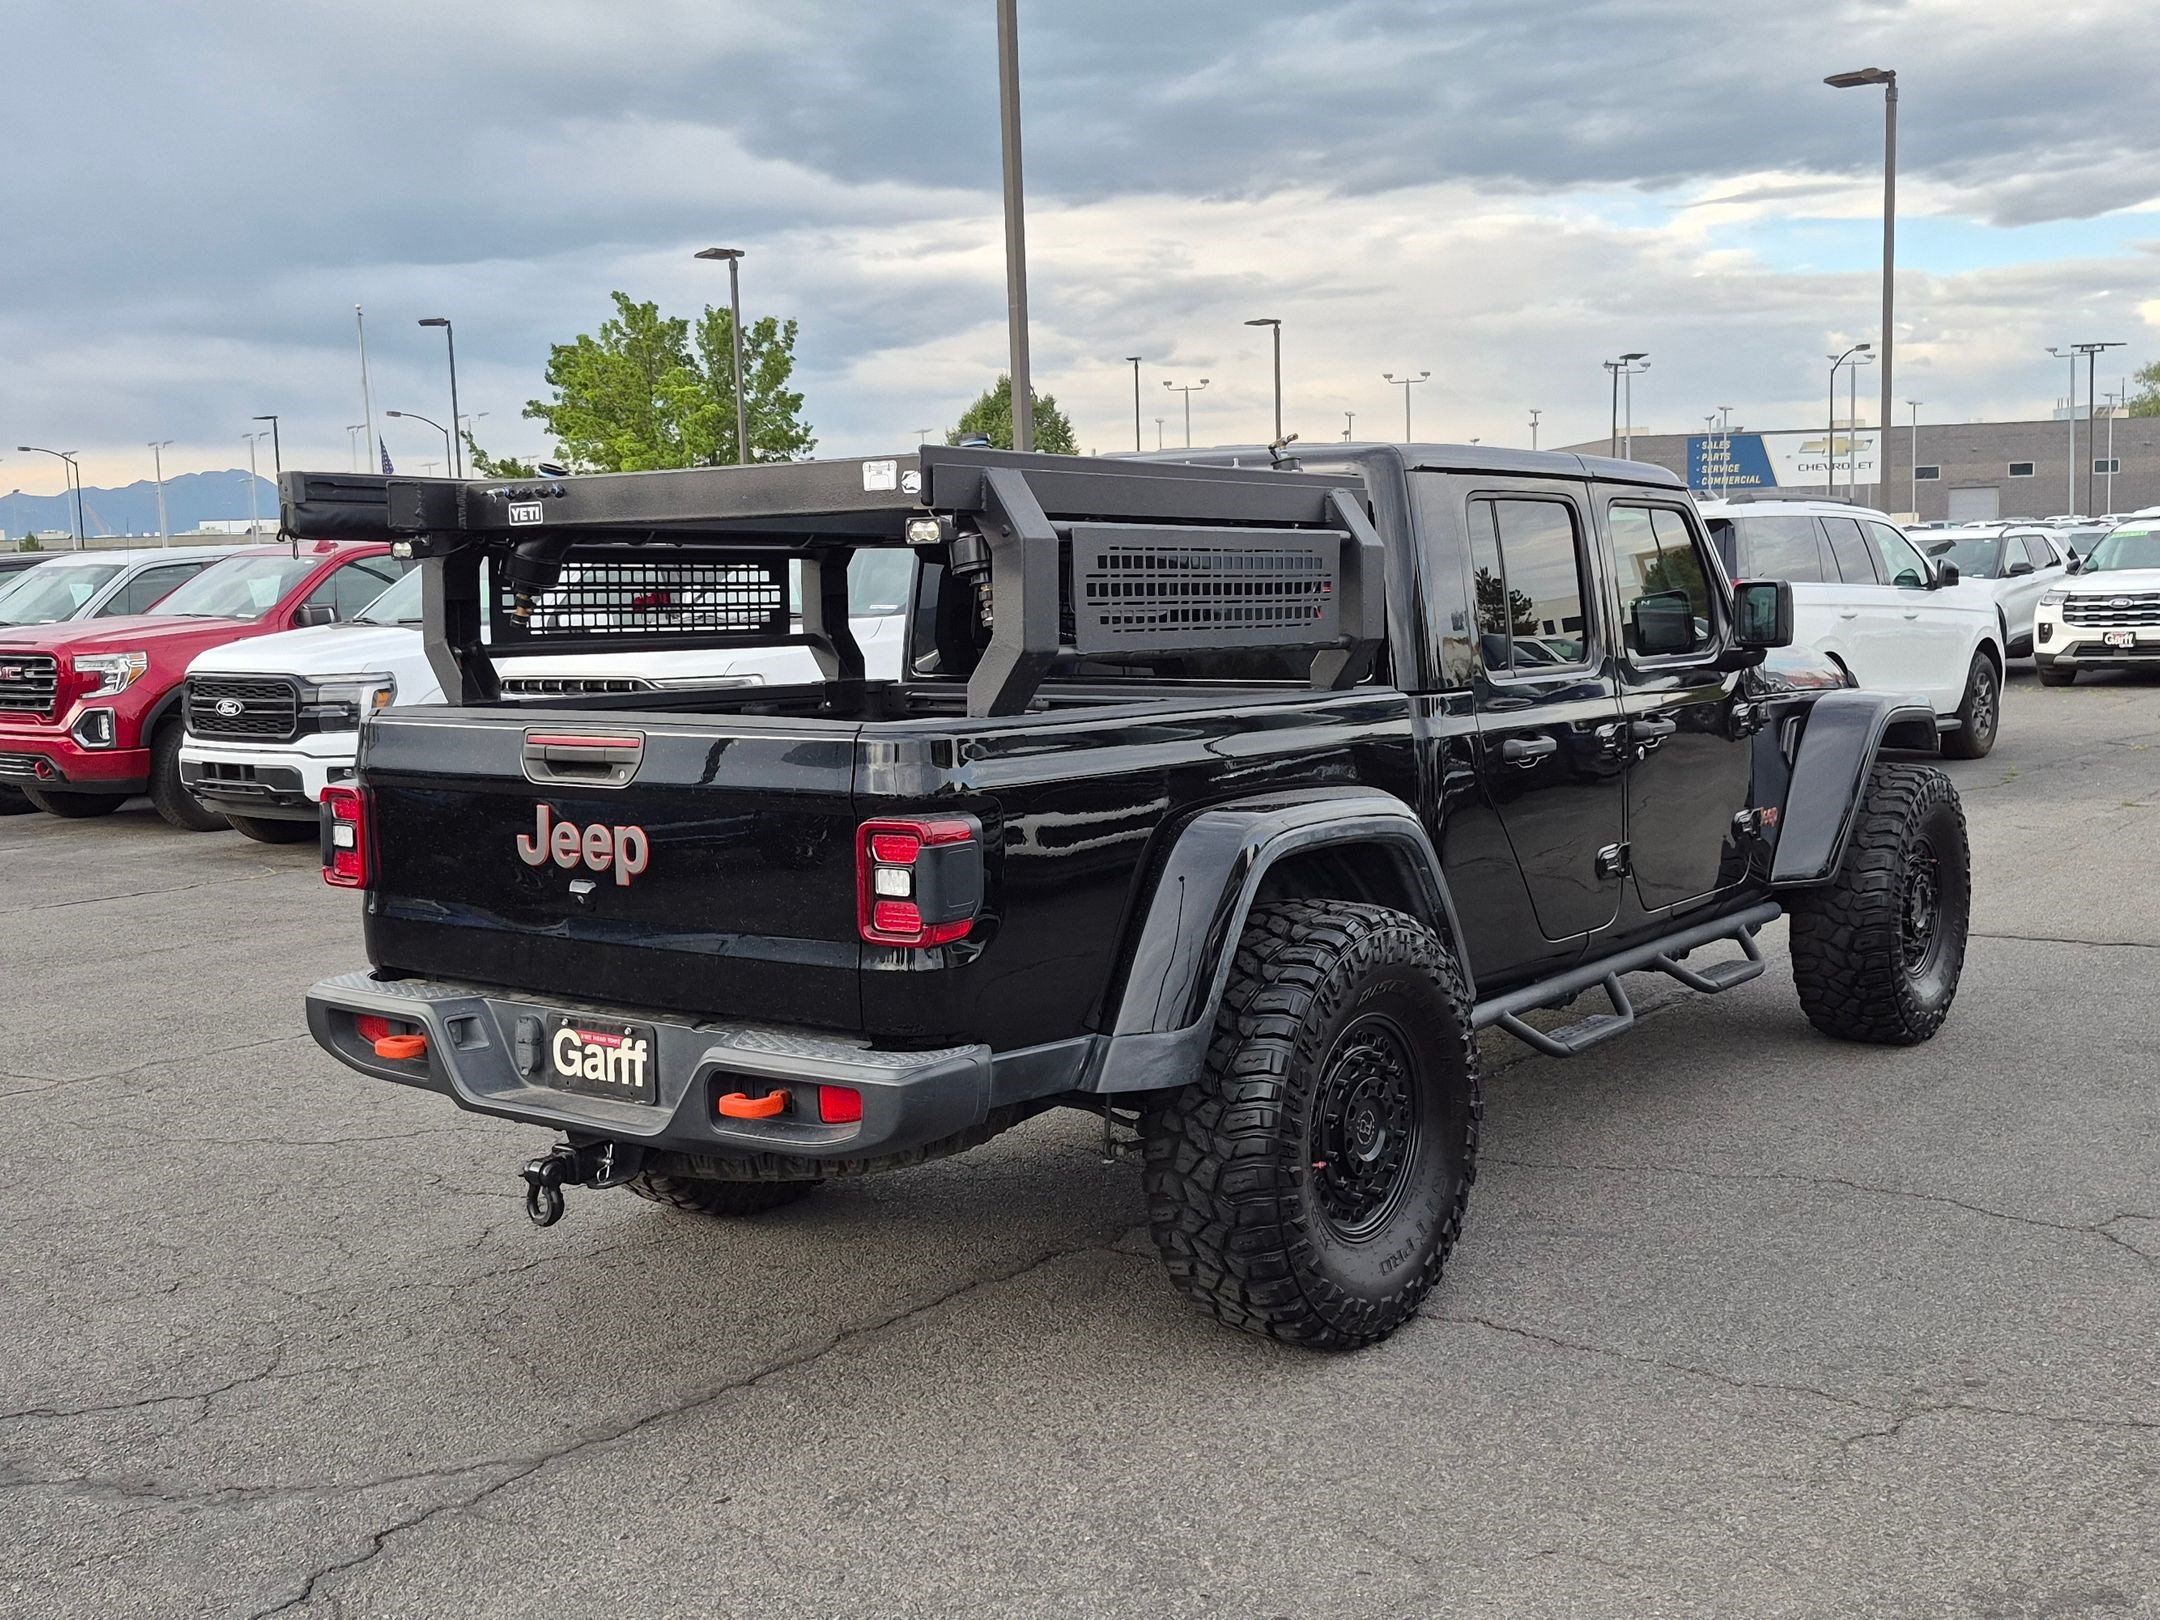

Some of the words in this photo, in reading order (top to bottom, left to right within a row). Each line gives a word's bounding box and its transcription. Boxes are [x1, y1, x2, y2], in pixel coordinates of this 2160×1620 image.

[1701, 441, 1731, 450] SALES
[1701, 453, 1731, 462] PARTS
[1701, 464, 1740, 474] SERVICE
[1701, 475, 1761, 486] COMMERCIAL
[511, 506, 540, 521] YETI
[516, 804, 649, 887] Jeep
[553, 1028, 648, 1087] Garff
